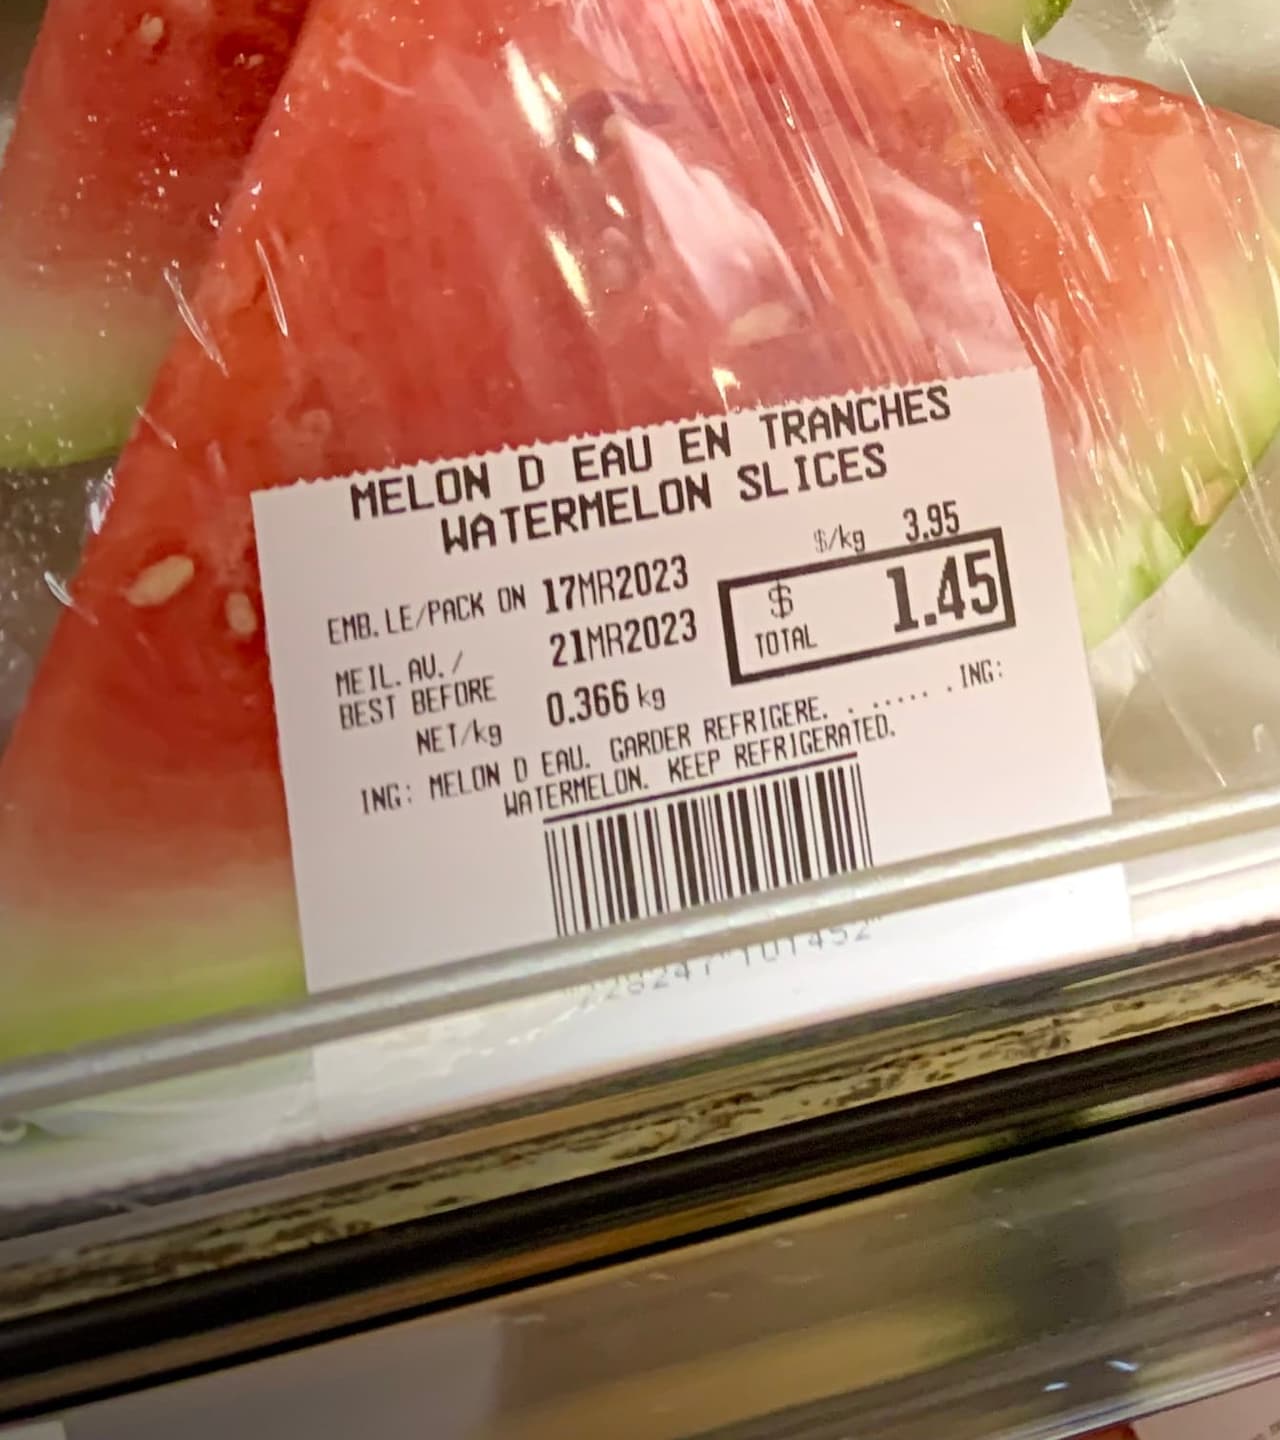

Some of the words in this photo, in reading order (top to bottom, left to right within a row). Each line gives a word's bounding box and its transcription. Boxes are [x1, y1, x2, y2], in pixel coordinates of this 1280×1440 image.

[350, 455, 491, 521] MELON
[518, 454, 545, 493] D
[573, 435, 652, 482] EAU
[678, 421, 731, 462] EN
[758, 385, 953, 449] TRANCHES
[440, 472, 712, 556] WATERMELON
[738, 442, 888, 503] SLICES
[812, 522, 866, 553] $/kg
[902, 500, 960, 543] 3.95
[497, 583, 527, 613] ON
[542, 554, 689, 615] 17MR2023
[767, 578, 794, 621] $
[886, 548, 999, 634] 1.45
[550, 608, 698, 668] 21MR2023
[754, 623, 818, 659] TOTAL
[338, 694, 397, 731] BEST
[410, 674, 497, 716] BEFORE
[416, 718, 503, 757] NET/kg
[545, 679, 630, 728] 0.366
[636, 683, 666, 711] kg
[360, 783, 412, 816] ING:
[429, 760, 501, 802] MELON
[513, 756, 528, 783] D
[541, 744, 591, 779] EAU.
[609, 722, 692, 764] GARDER
[703, 695, 828, 744] REFRIGERE.
[503, 764, 649, 819] WATERMELON.
[667, 747, 722, 785] KEEP
[733, 713, 897, 770] REFRIGERATED.
